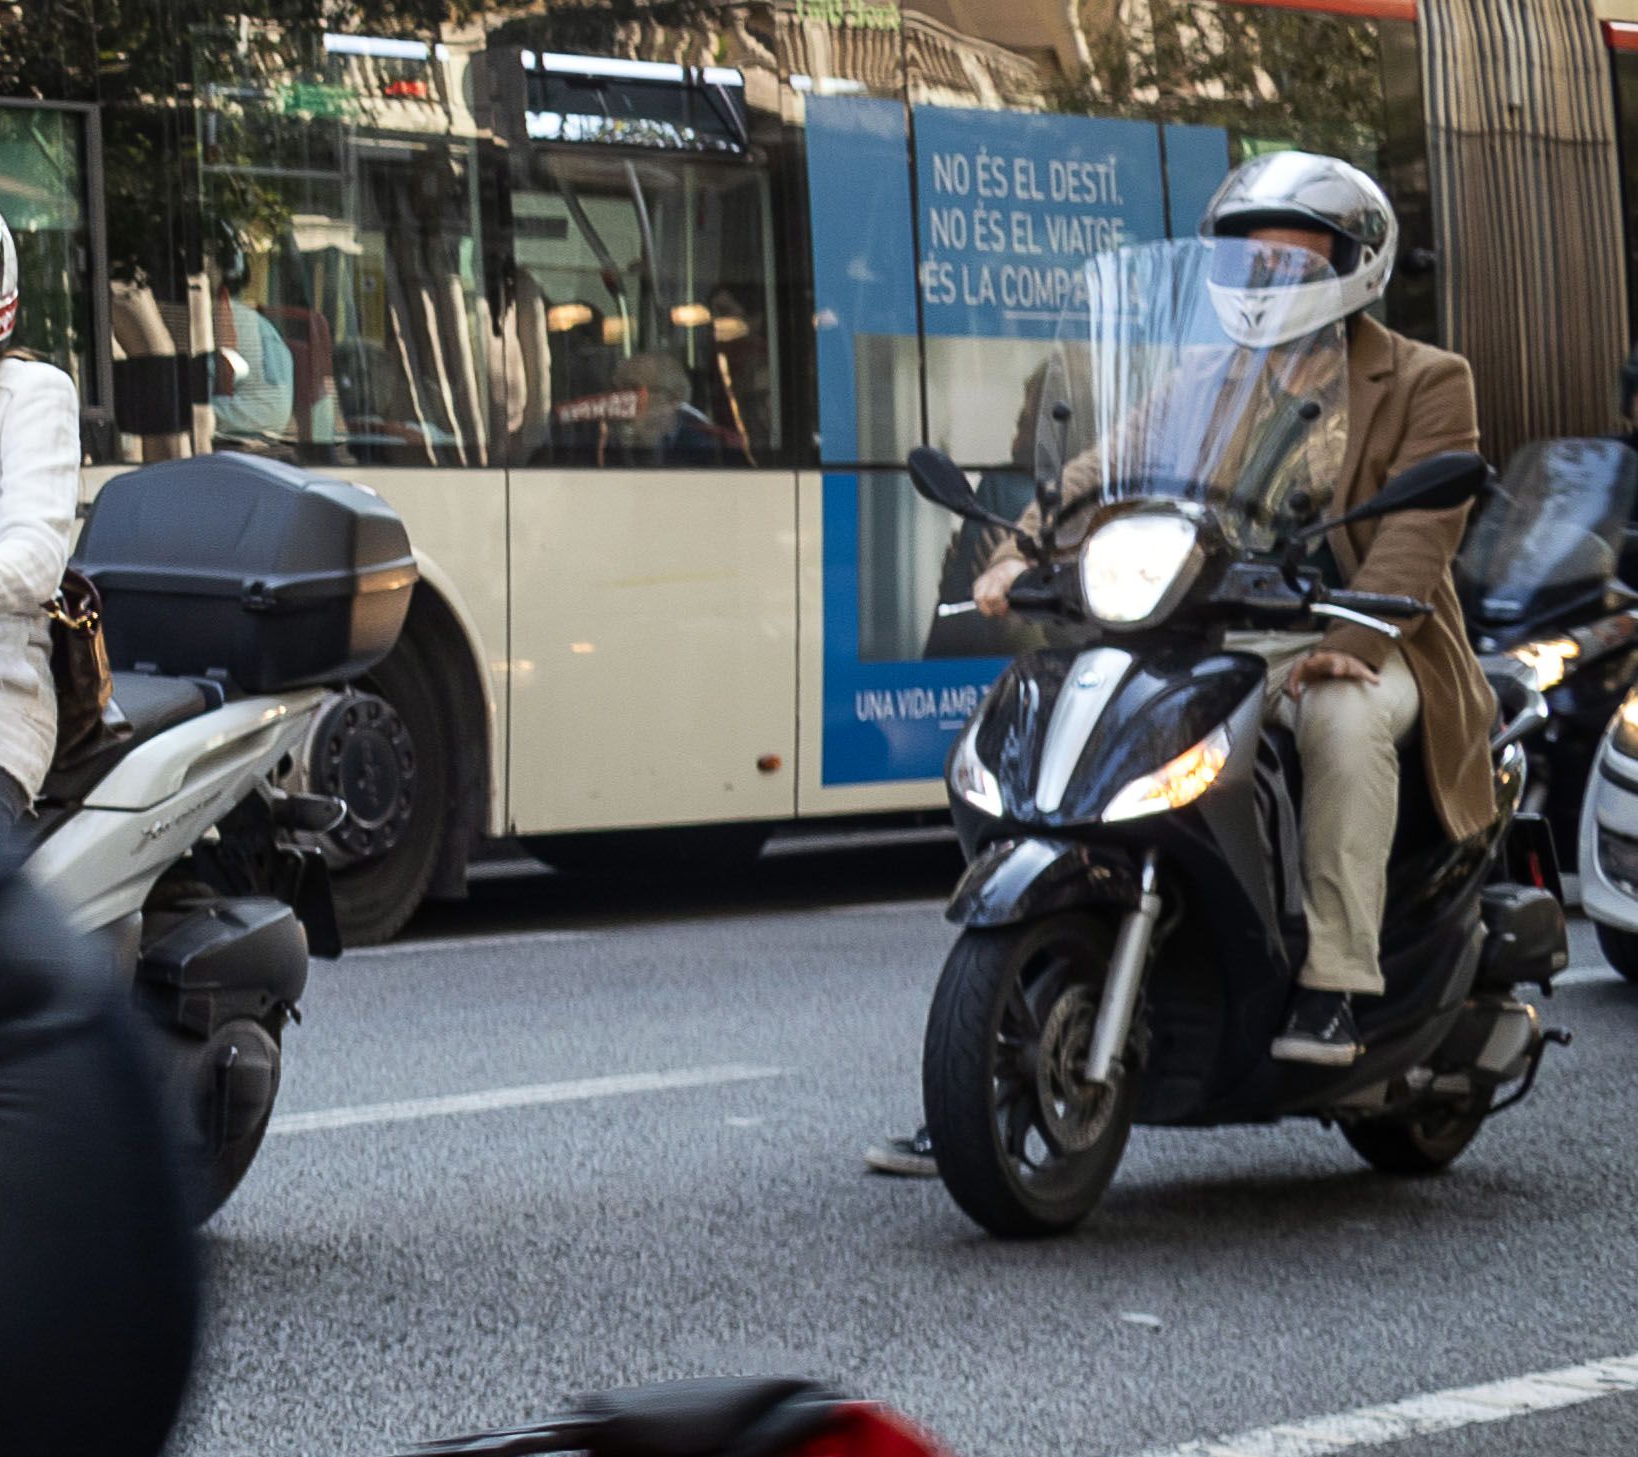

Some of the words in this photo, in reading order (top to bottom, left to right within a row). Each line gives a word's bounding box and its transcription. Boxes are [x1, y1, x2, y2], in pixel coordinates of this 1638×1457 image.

[932, 152, 971, 196] NO
[976, 145, 1009, 198] ÉS
[1013, 157, 1045, 201] EL
[1049, 153, 1124, 206] DESTÍ.
[929, 207, 968, 251] NO
[973, 199, 1006, 253] ÉS
[1010, 211, 1043, 254] EL
[921, 249, 957, 304] ÉS
[962, 263, 997, 307] LA
[856, 689, 895, 722] UNA
[896, 687, 936, 720] VIDA
